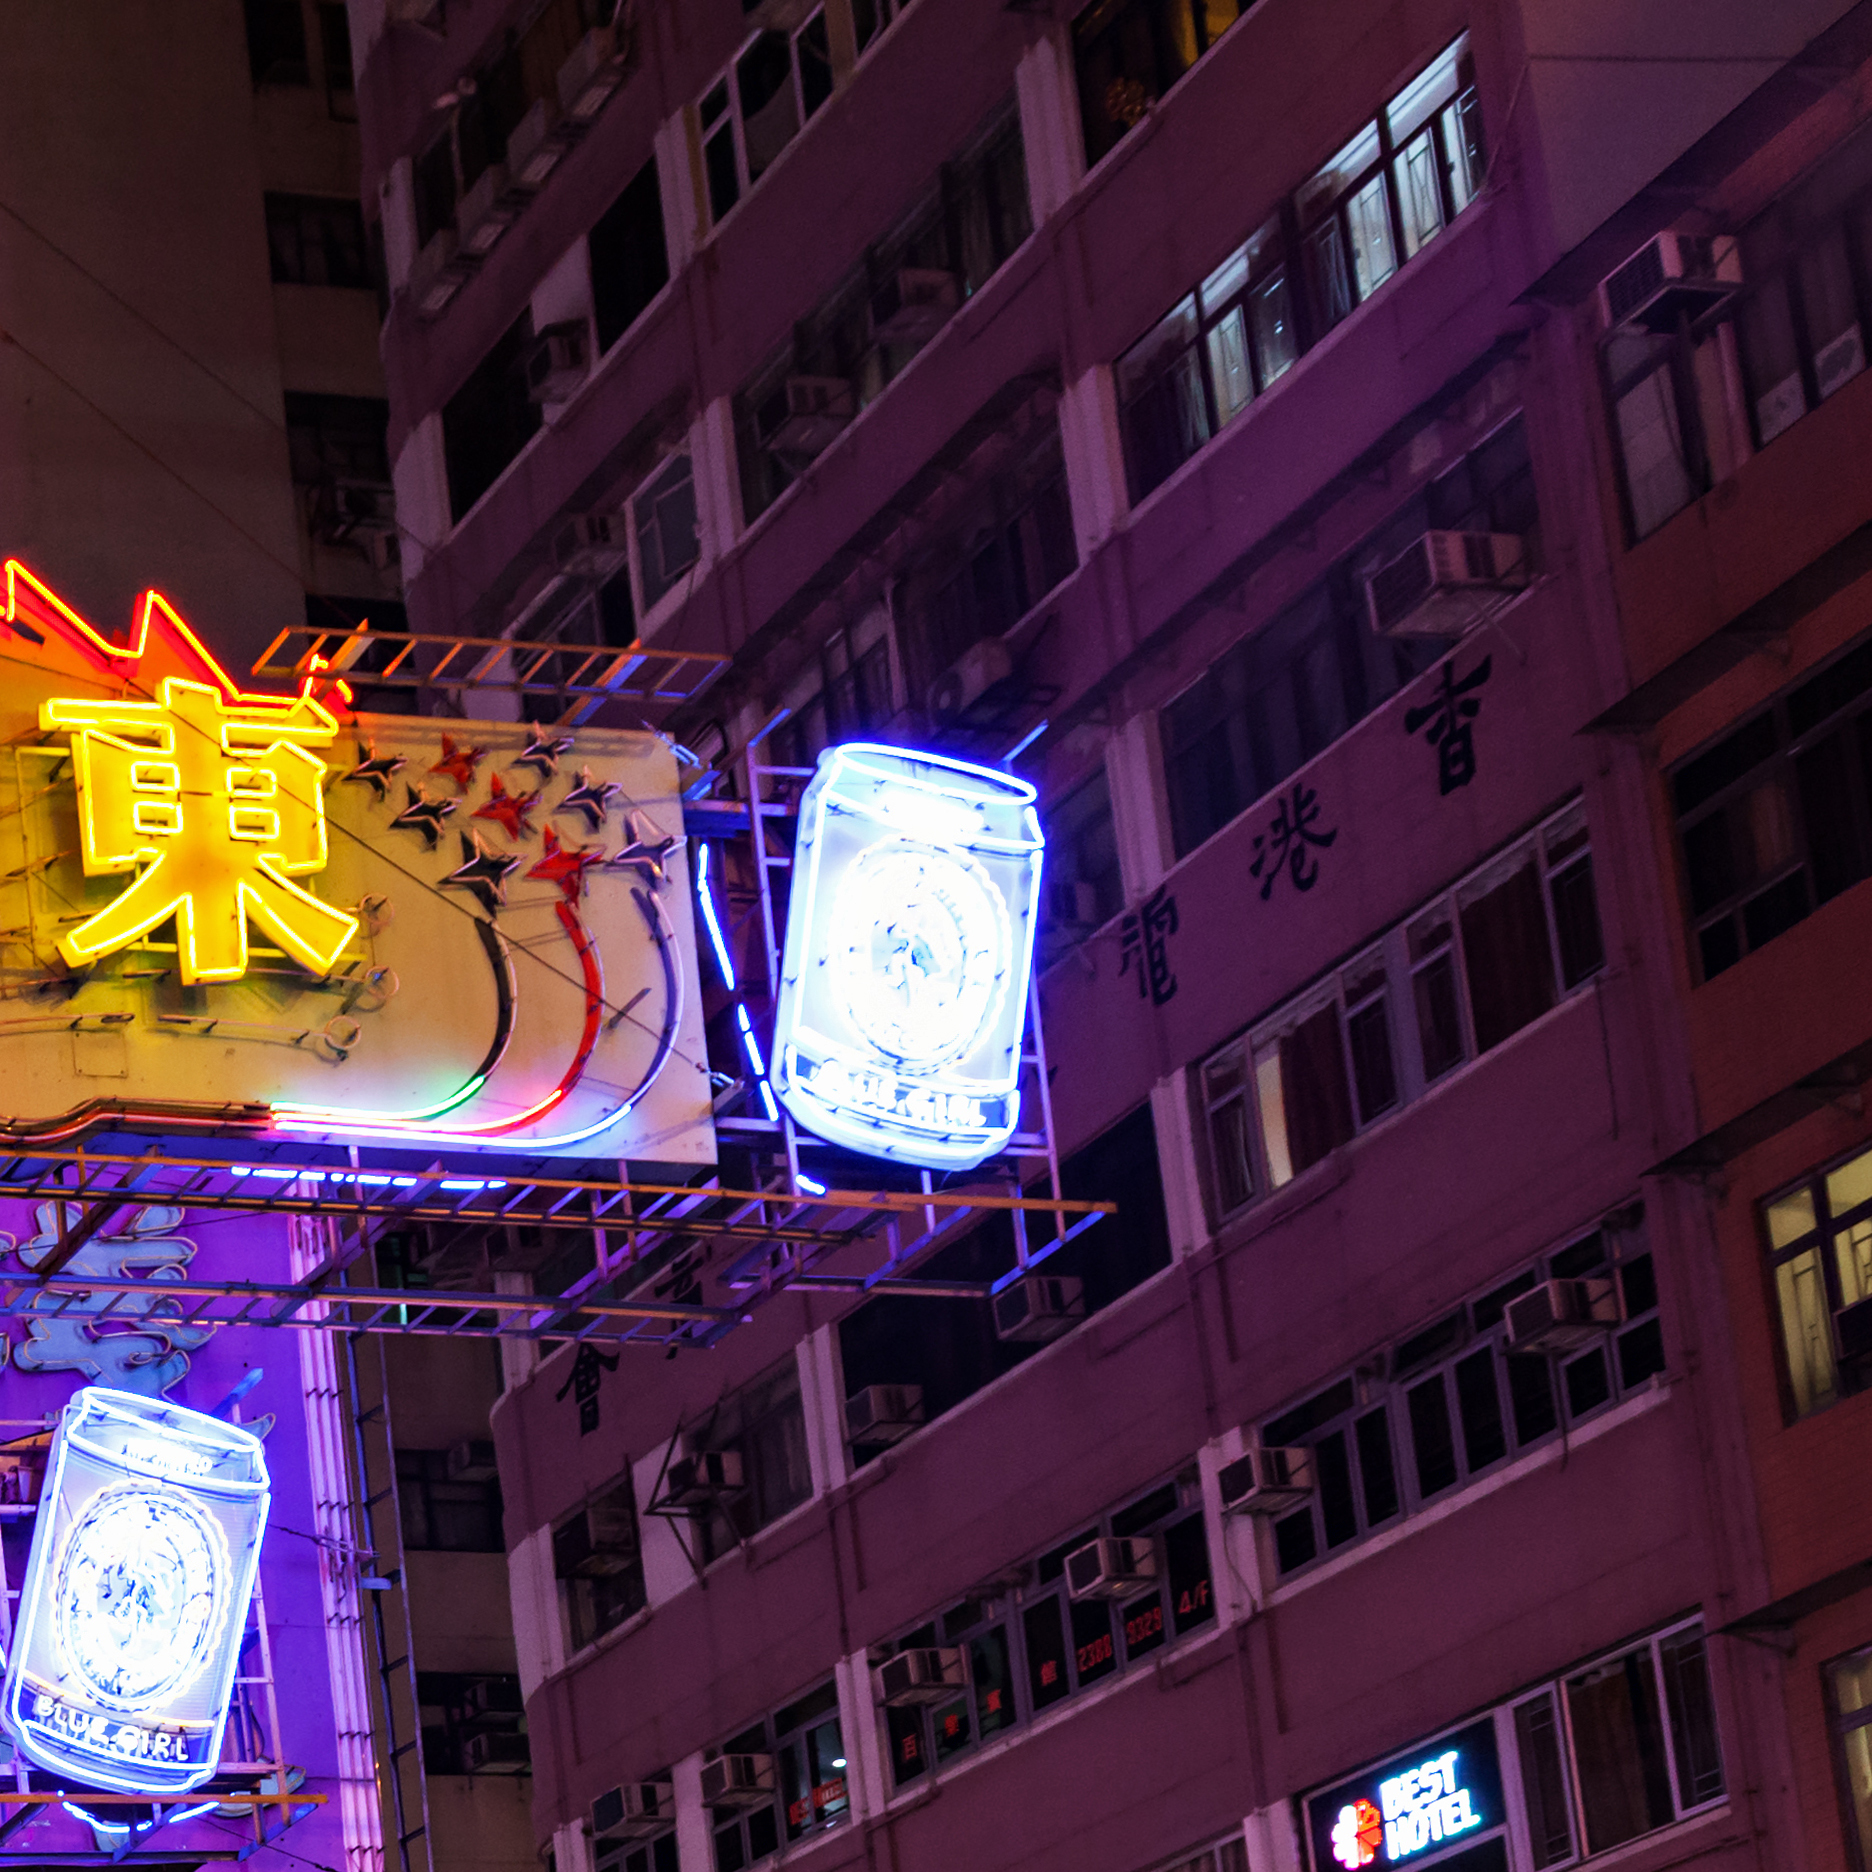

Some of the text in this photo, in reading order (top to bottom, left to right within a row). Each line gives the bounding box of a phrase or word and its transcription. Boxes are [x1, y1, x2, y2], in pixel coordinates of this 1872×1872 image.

[35, 1695, 190, 1762] BLUE GIRL
[1380, 1751, 1458, 1821] BEST
[1385, 1789, 1481, 1860] HOTEL
